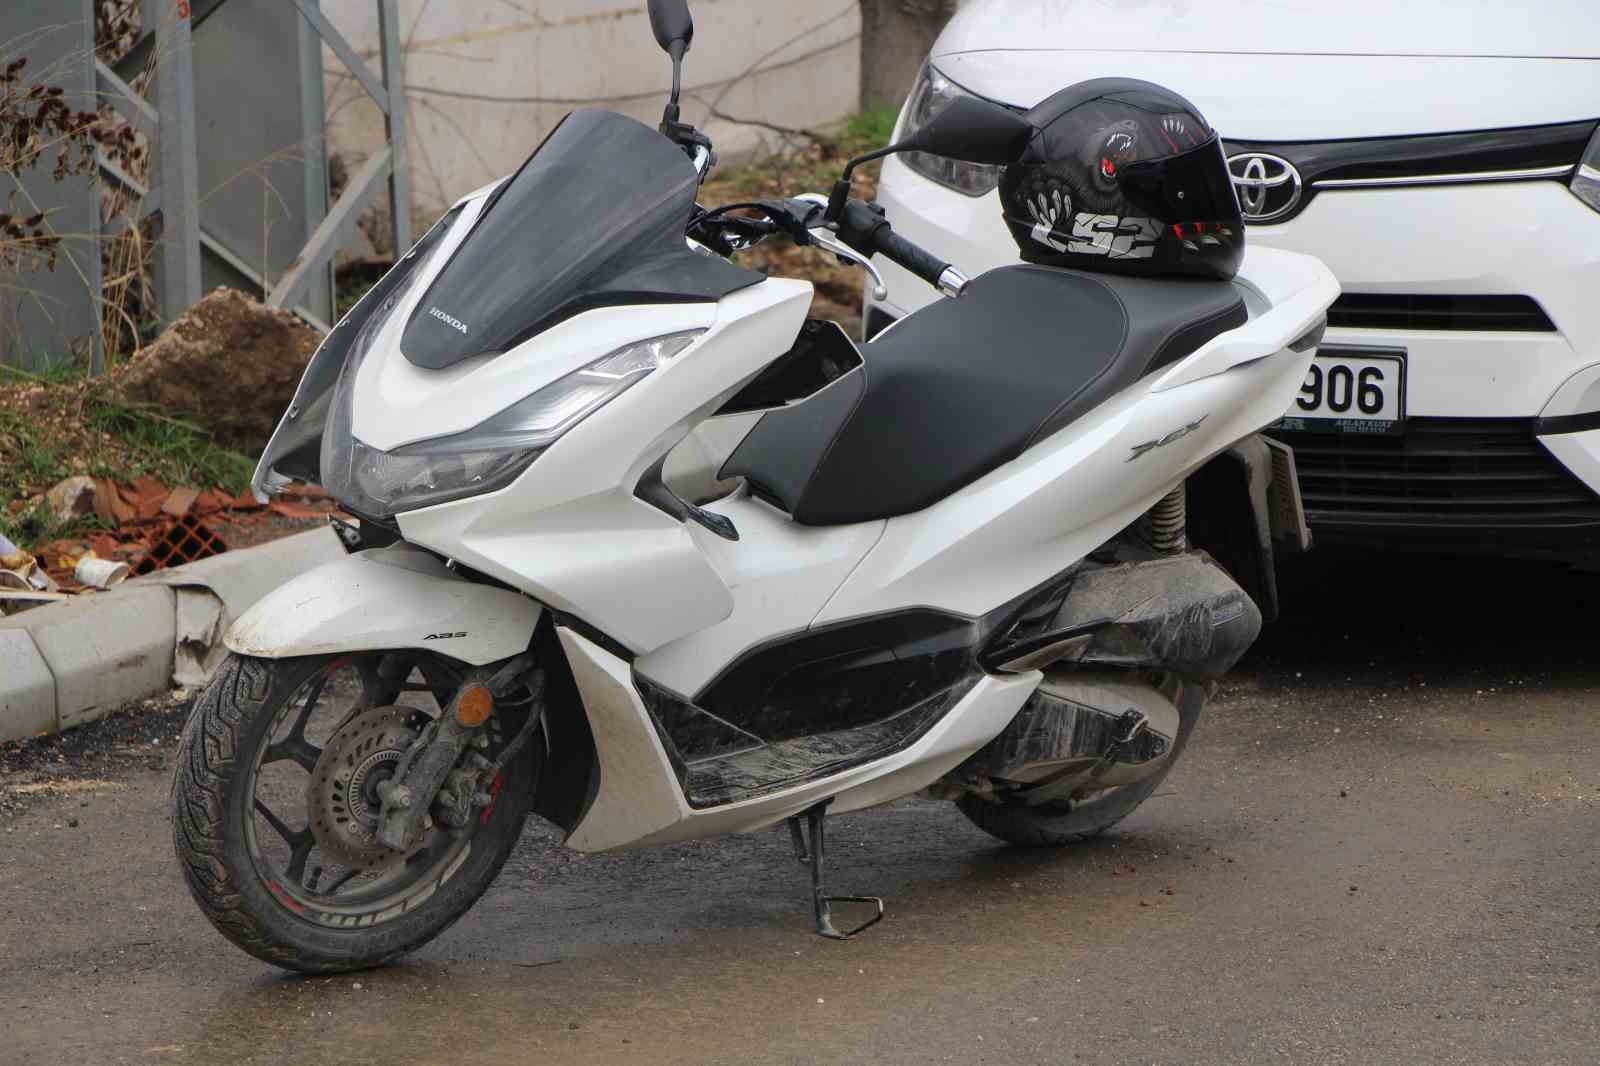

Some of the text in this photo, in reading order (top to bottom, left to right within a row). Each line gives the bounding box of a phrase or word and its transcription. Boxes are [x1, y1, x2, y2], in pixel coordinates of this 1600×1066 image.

[429, 306, 468, 334] HONDA
[1296, 364, 1384, 414] 906
[423, 631, 468, 640] ABS
